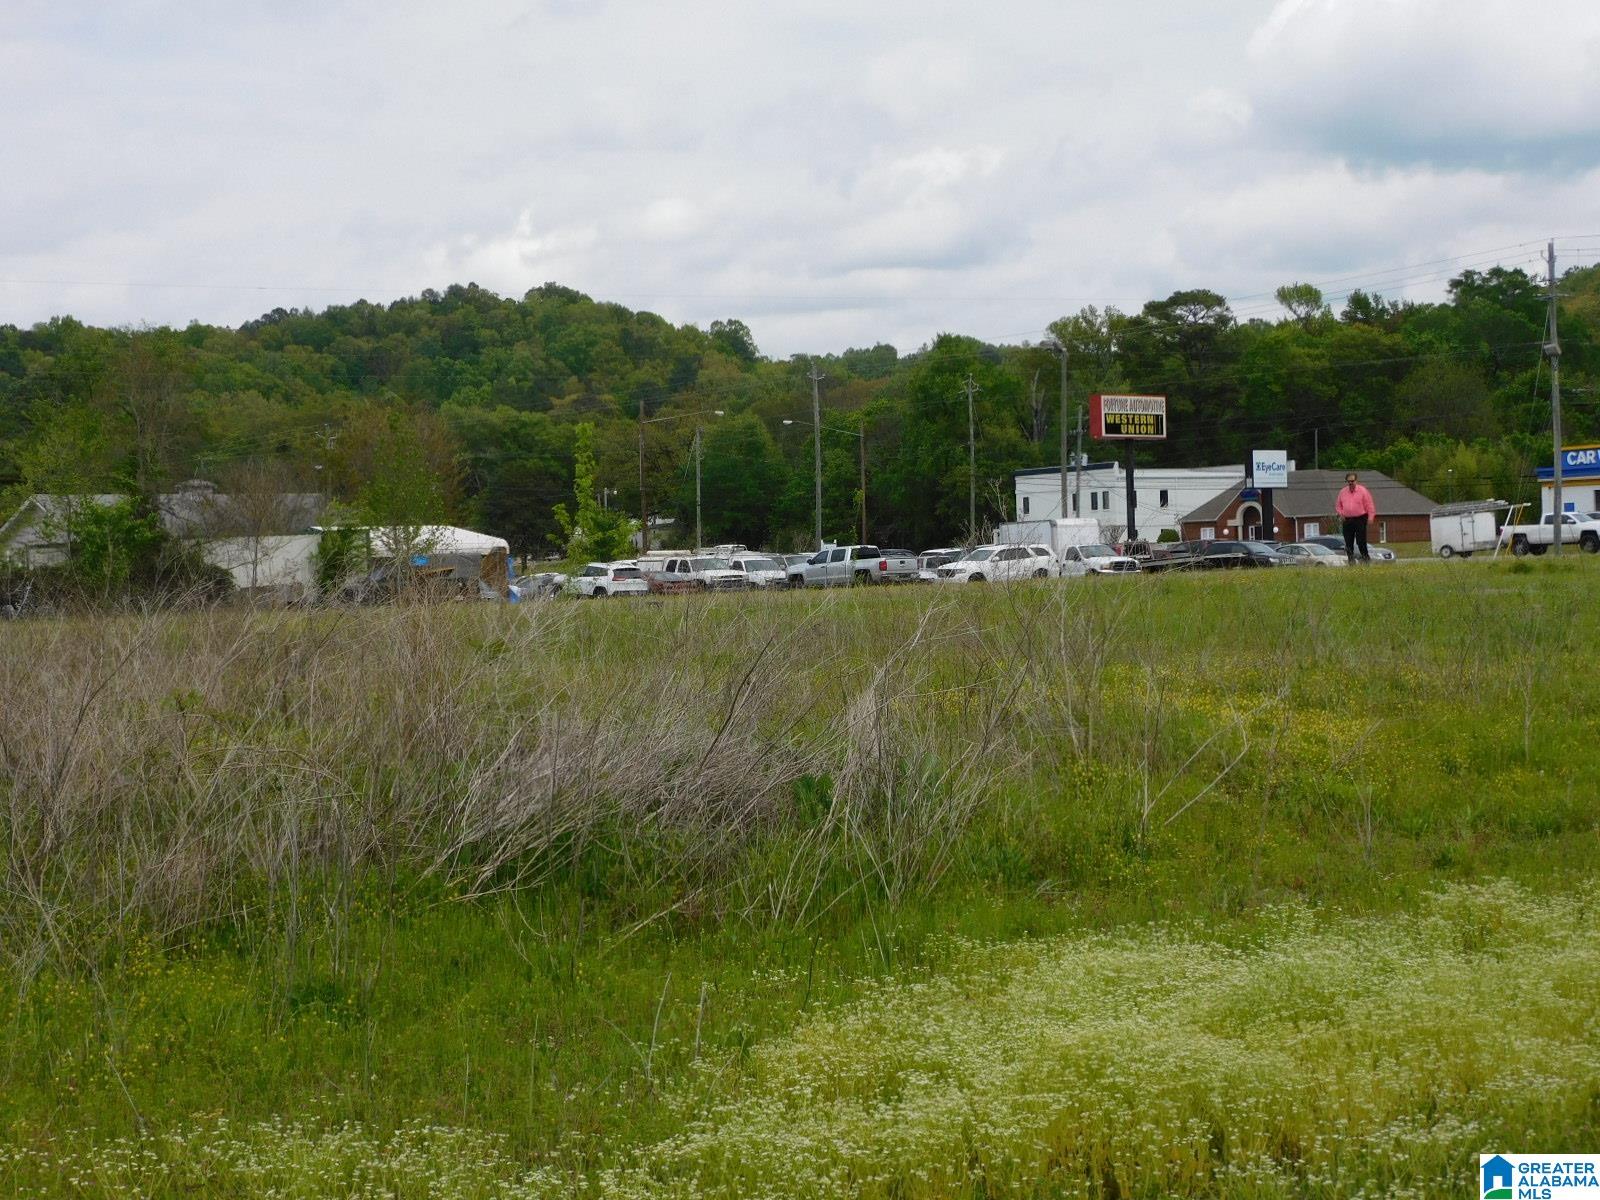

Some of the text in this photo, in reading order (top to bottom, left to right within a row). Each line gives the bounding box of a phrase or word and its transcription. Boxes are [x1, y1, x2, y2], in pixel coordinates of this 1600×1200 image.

[1106, 414, 1154, 424] WESTERN
[1121, 424, 1154, 434] UNION
[1567, 450, 1596, 465] CAR
[1261, 461, 1286, 473] EyeCare
